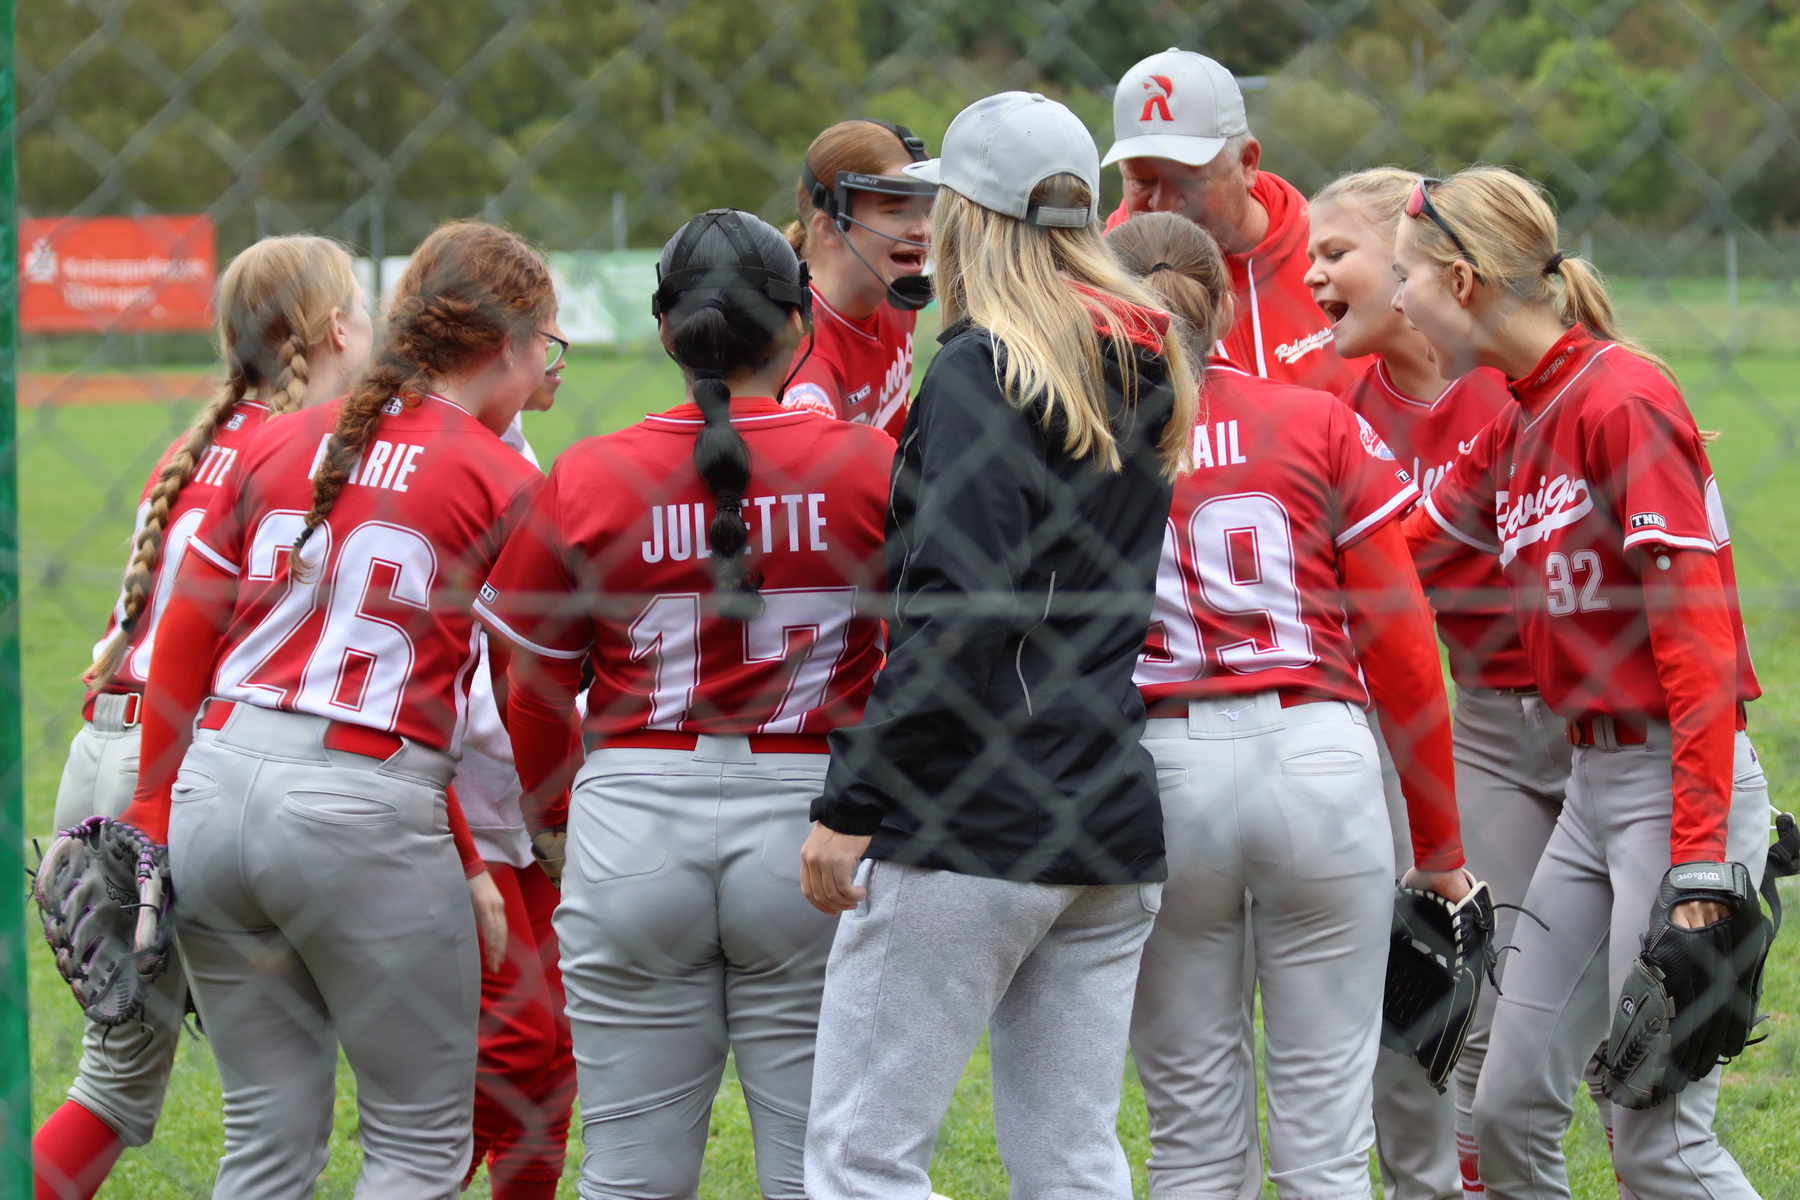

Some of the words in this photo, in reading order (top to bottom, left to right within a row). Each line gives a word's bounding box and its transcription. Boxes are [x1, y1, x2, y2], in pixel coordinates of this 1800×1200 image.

[642, 493, 828, 563] JULETTE
[1632, 513, 1665, 528] TNKD
[214, 509, 437, 722] 26
[1546, 549, 1611, 617] 32
[628, 586, 858, 734] 17
[1678, 870, 1720, 881] Wilson
